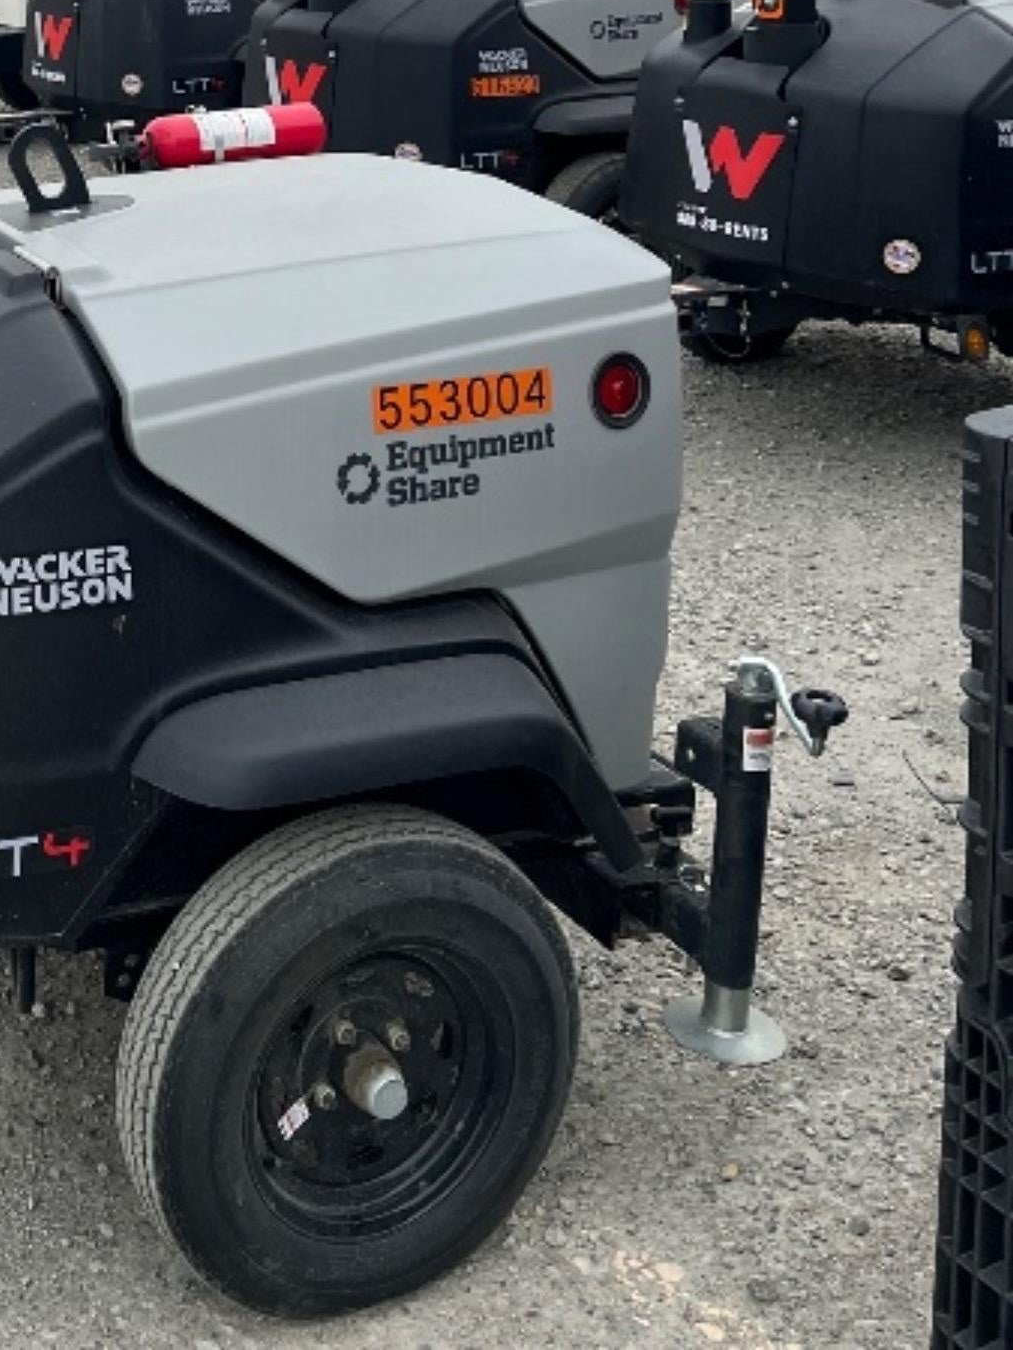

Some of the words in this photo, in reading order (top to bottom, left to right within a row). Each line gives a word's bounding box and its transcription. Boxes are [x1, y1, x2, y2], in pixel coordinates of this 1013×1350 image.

[377, 369, 547, 431] 553004
[385, 422, 556, 474] Equipment
[387, 472, 481, 507] Share
